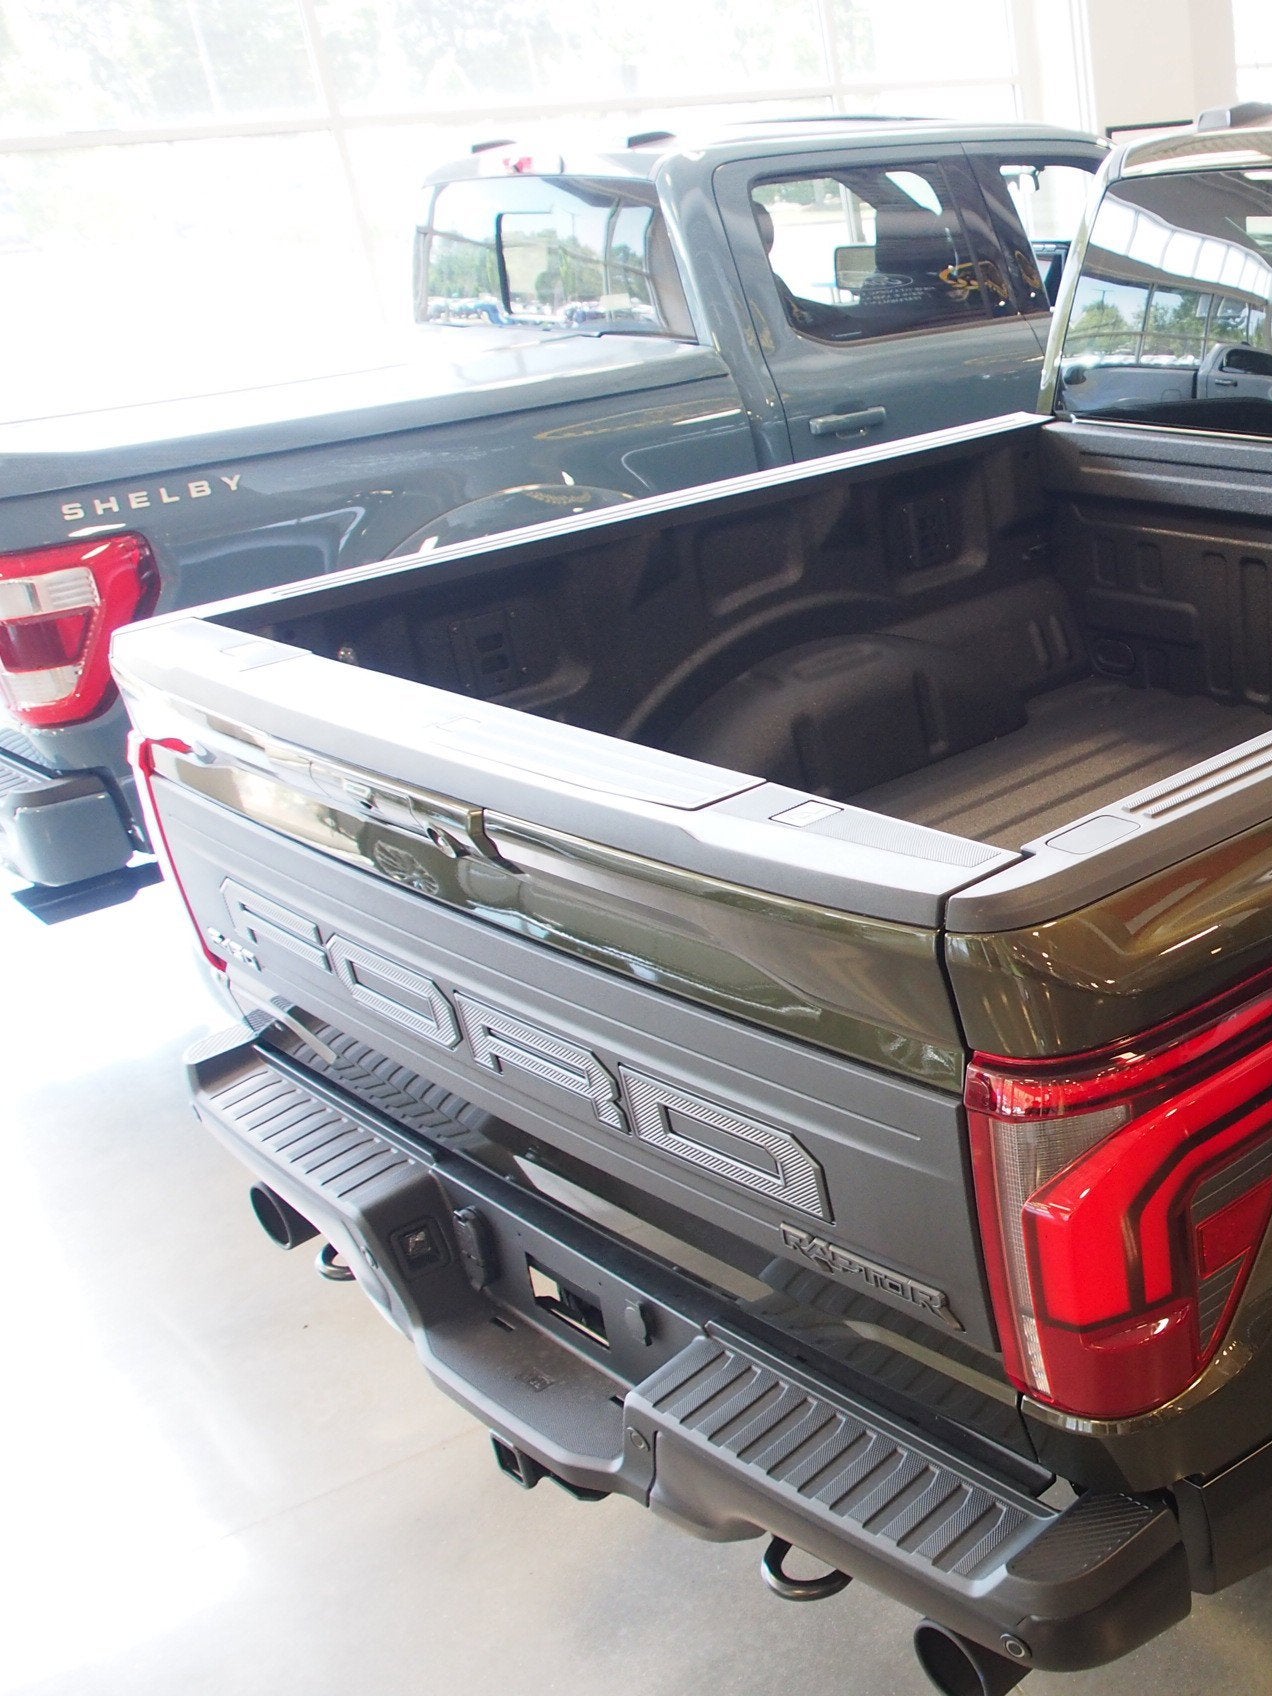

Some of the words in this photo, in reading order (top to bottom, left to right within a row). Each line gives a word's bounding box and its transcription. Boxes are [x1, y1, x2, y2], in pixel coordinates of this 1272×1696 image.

[60, 474, 241, 521] SHELBY
[218, 876, 836, 1226] FORD
[780, 1222, 968, 1334] RAPTOR
